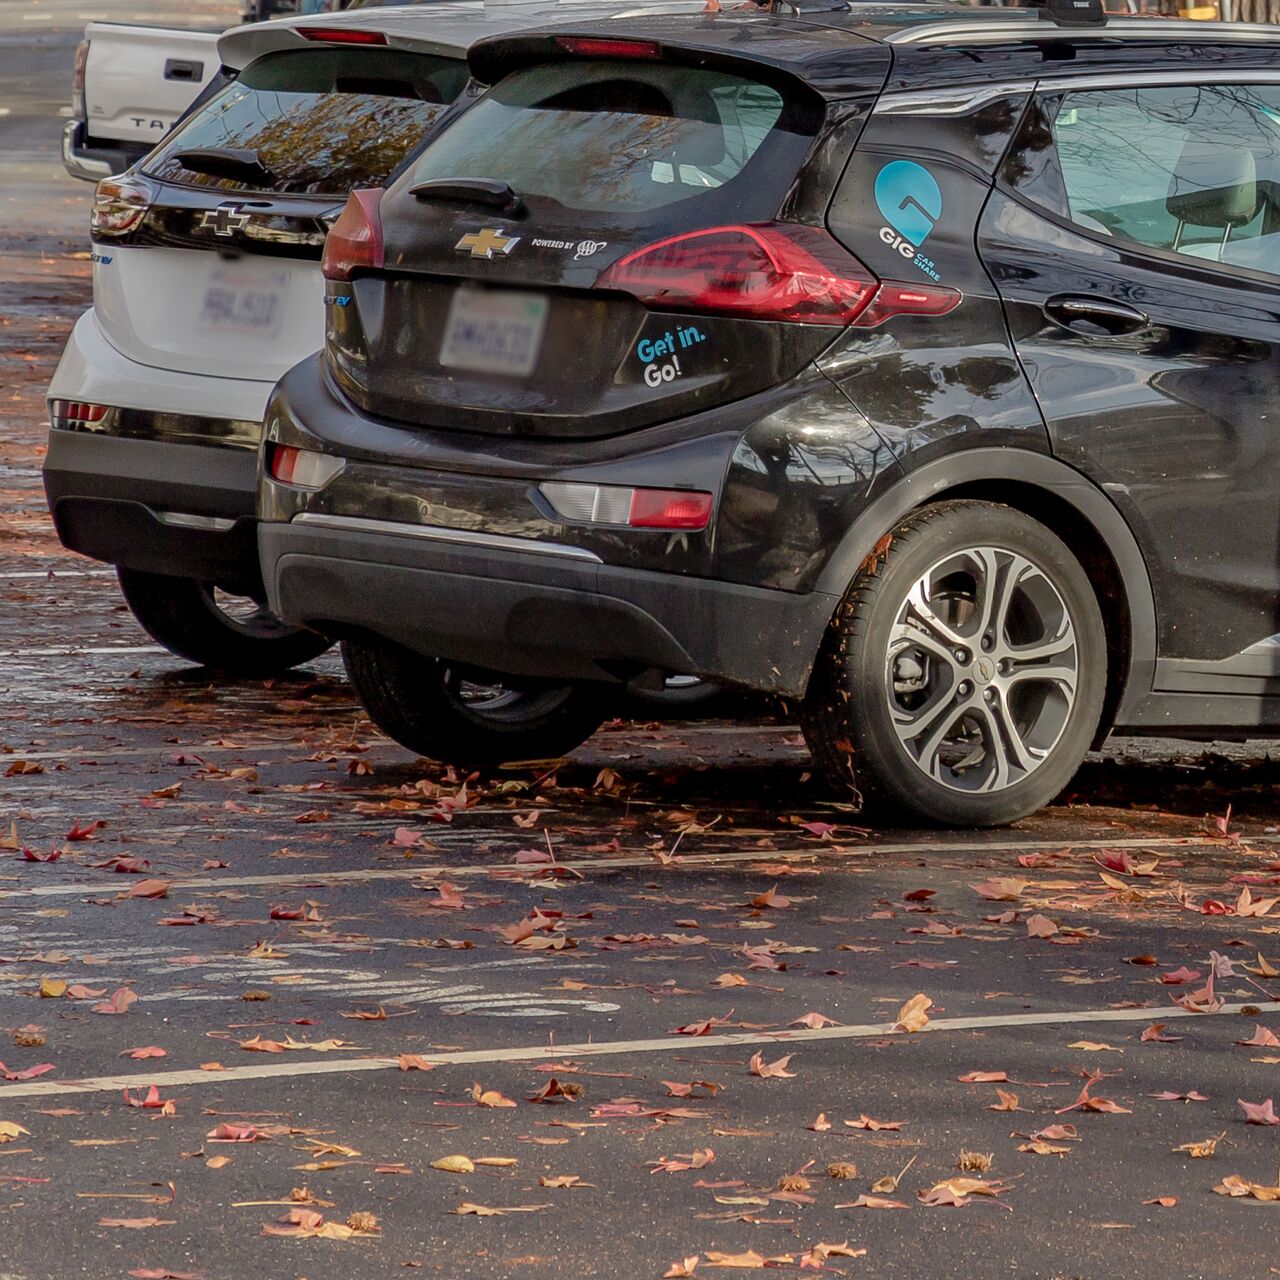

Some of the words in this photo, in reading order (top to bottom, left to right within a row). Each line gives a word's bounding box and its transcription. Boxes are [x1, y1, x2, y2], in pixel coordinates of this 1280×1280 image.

[532, 239, 563, 249] POWERED
[564, 241, 575, 250] BY
[879, 227, 915, 259] GIG
[913, 258, 941, 282] SHARE
[916, 253, 935, 269] CAR
[637, 331, 675, 363] Get
[677, 325, 706, 348] in.
[644, 354, 682, 388] Go!
